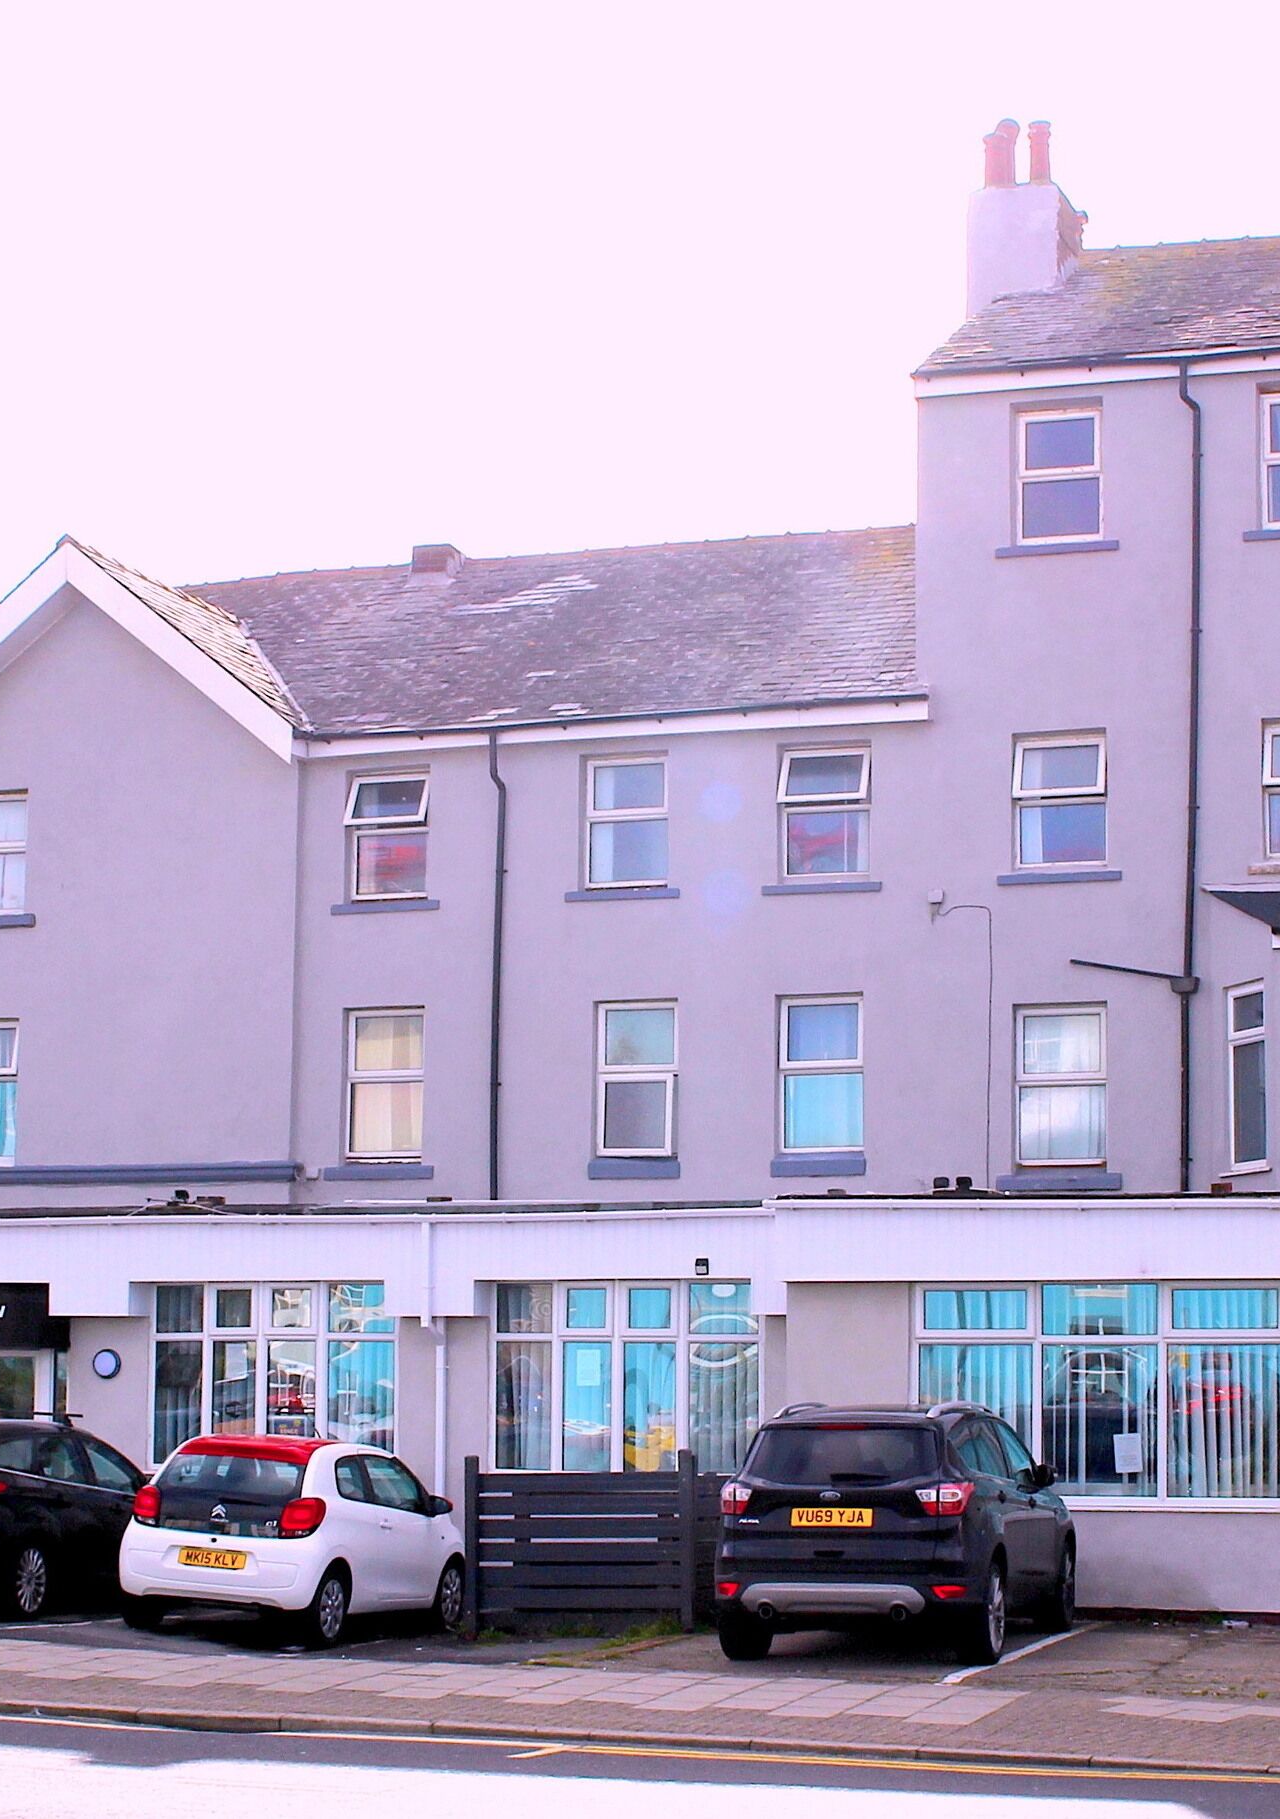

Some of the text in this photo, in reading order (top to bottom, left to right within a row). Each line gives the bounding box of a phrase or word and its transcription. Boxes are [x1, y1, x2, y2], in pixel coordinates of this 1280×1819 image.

[797, 1509, 865, 1523] VU69 YJA
[185, 1551, 238, 1566] MK15 KLV
